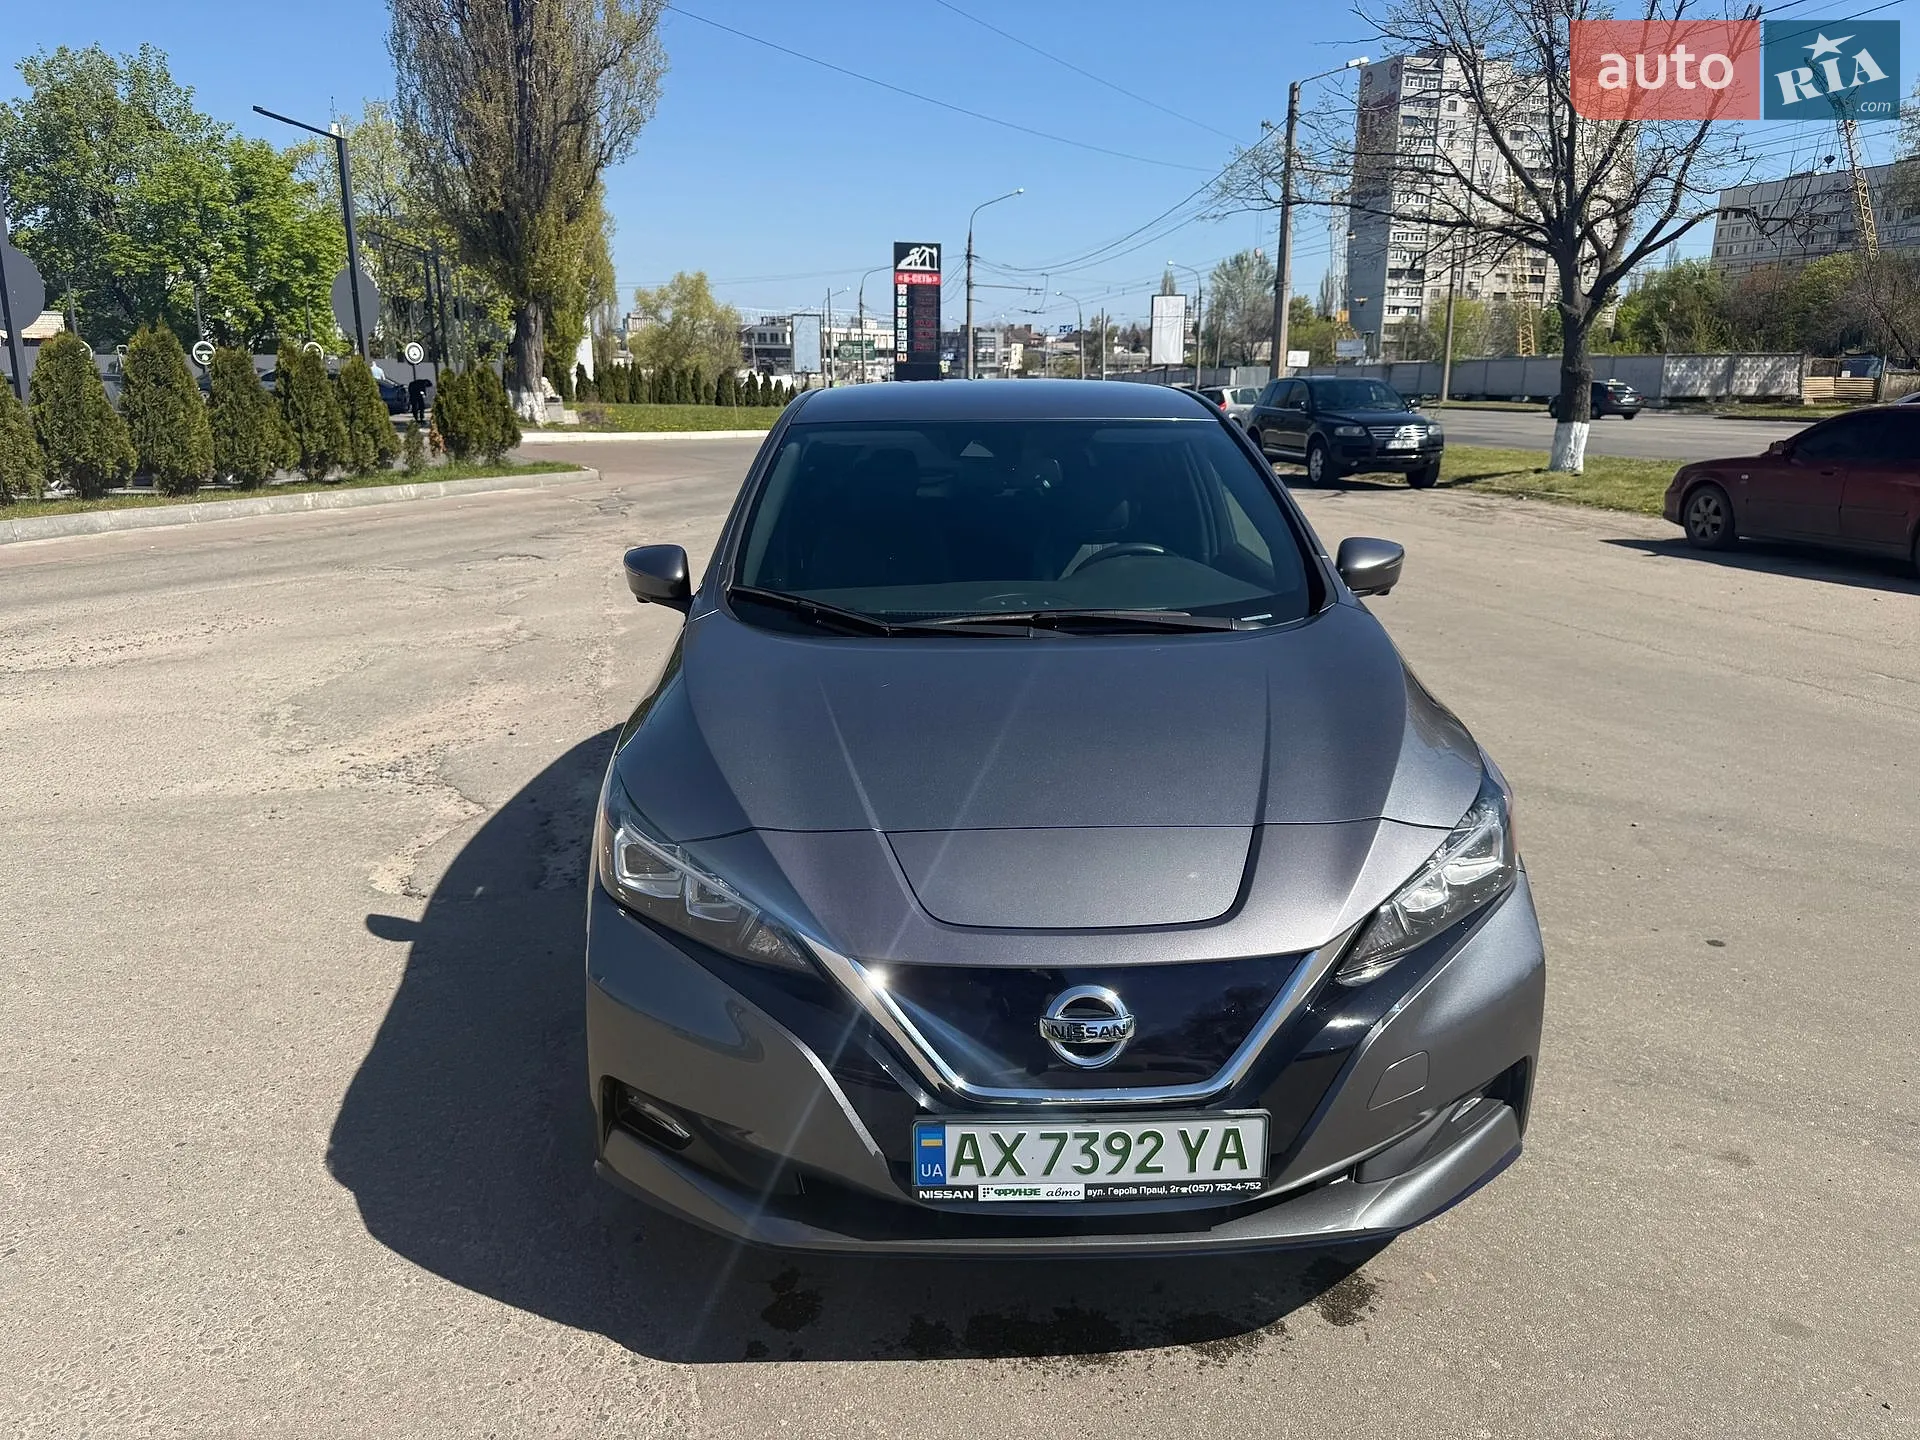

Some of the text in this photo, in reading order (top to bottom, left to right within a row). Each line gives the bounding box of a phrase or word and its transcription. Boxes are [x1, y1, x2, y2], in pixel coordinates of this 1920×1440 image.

[1050, 1022, 1126, 1041] NISSAN
[951, 1126, 1248, 1177] AX 7392 YA
[921, 1164, 944, 1178] UA
[994, 1187, 1081, 1197] ФРУНЗЕ авто
[1215, 1182, 1262, 1192] 752-4-752
[919, 1190, 974, 1200] NISSAN
